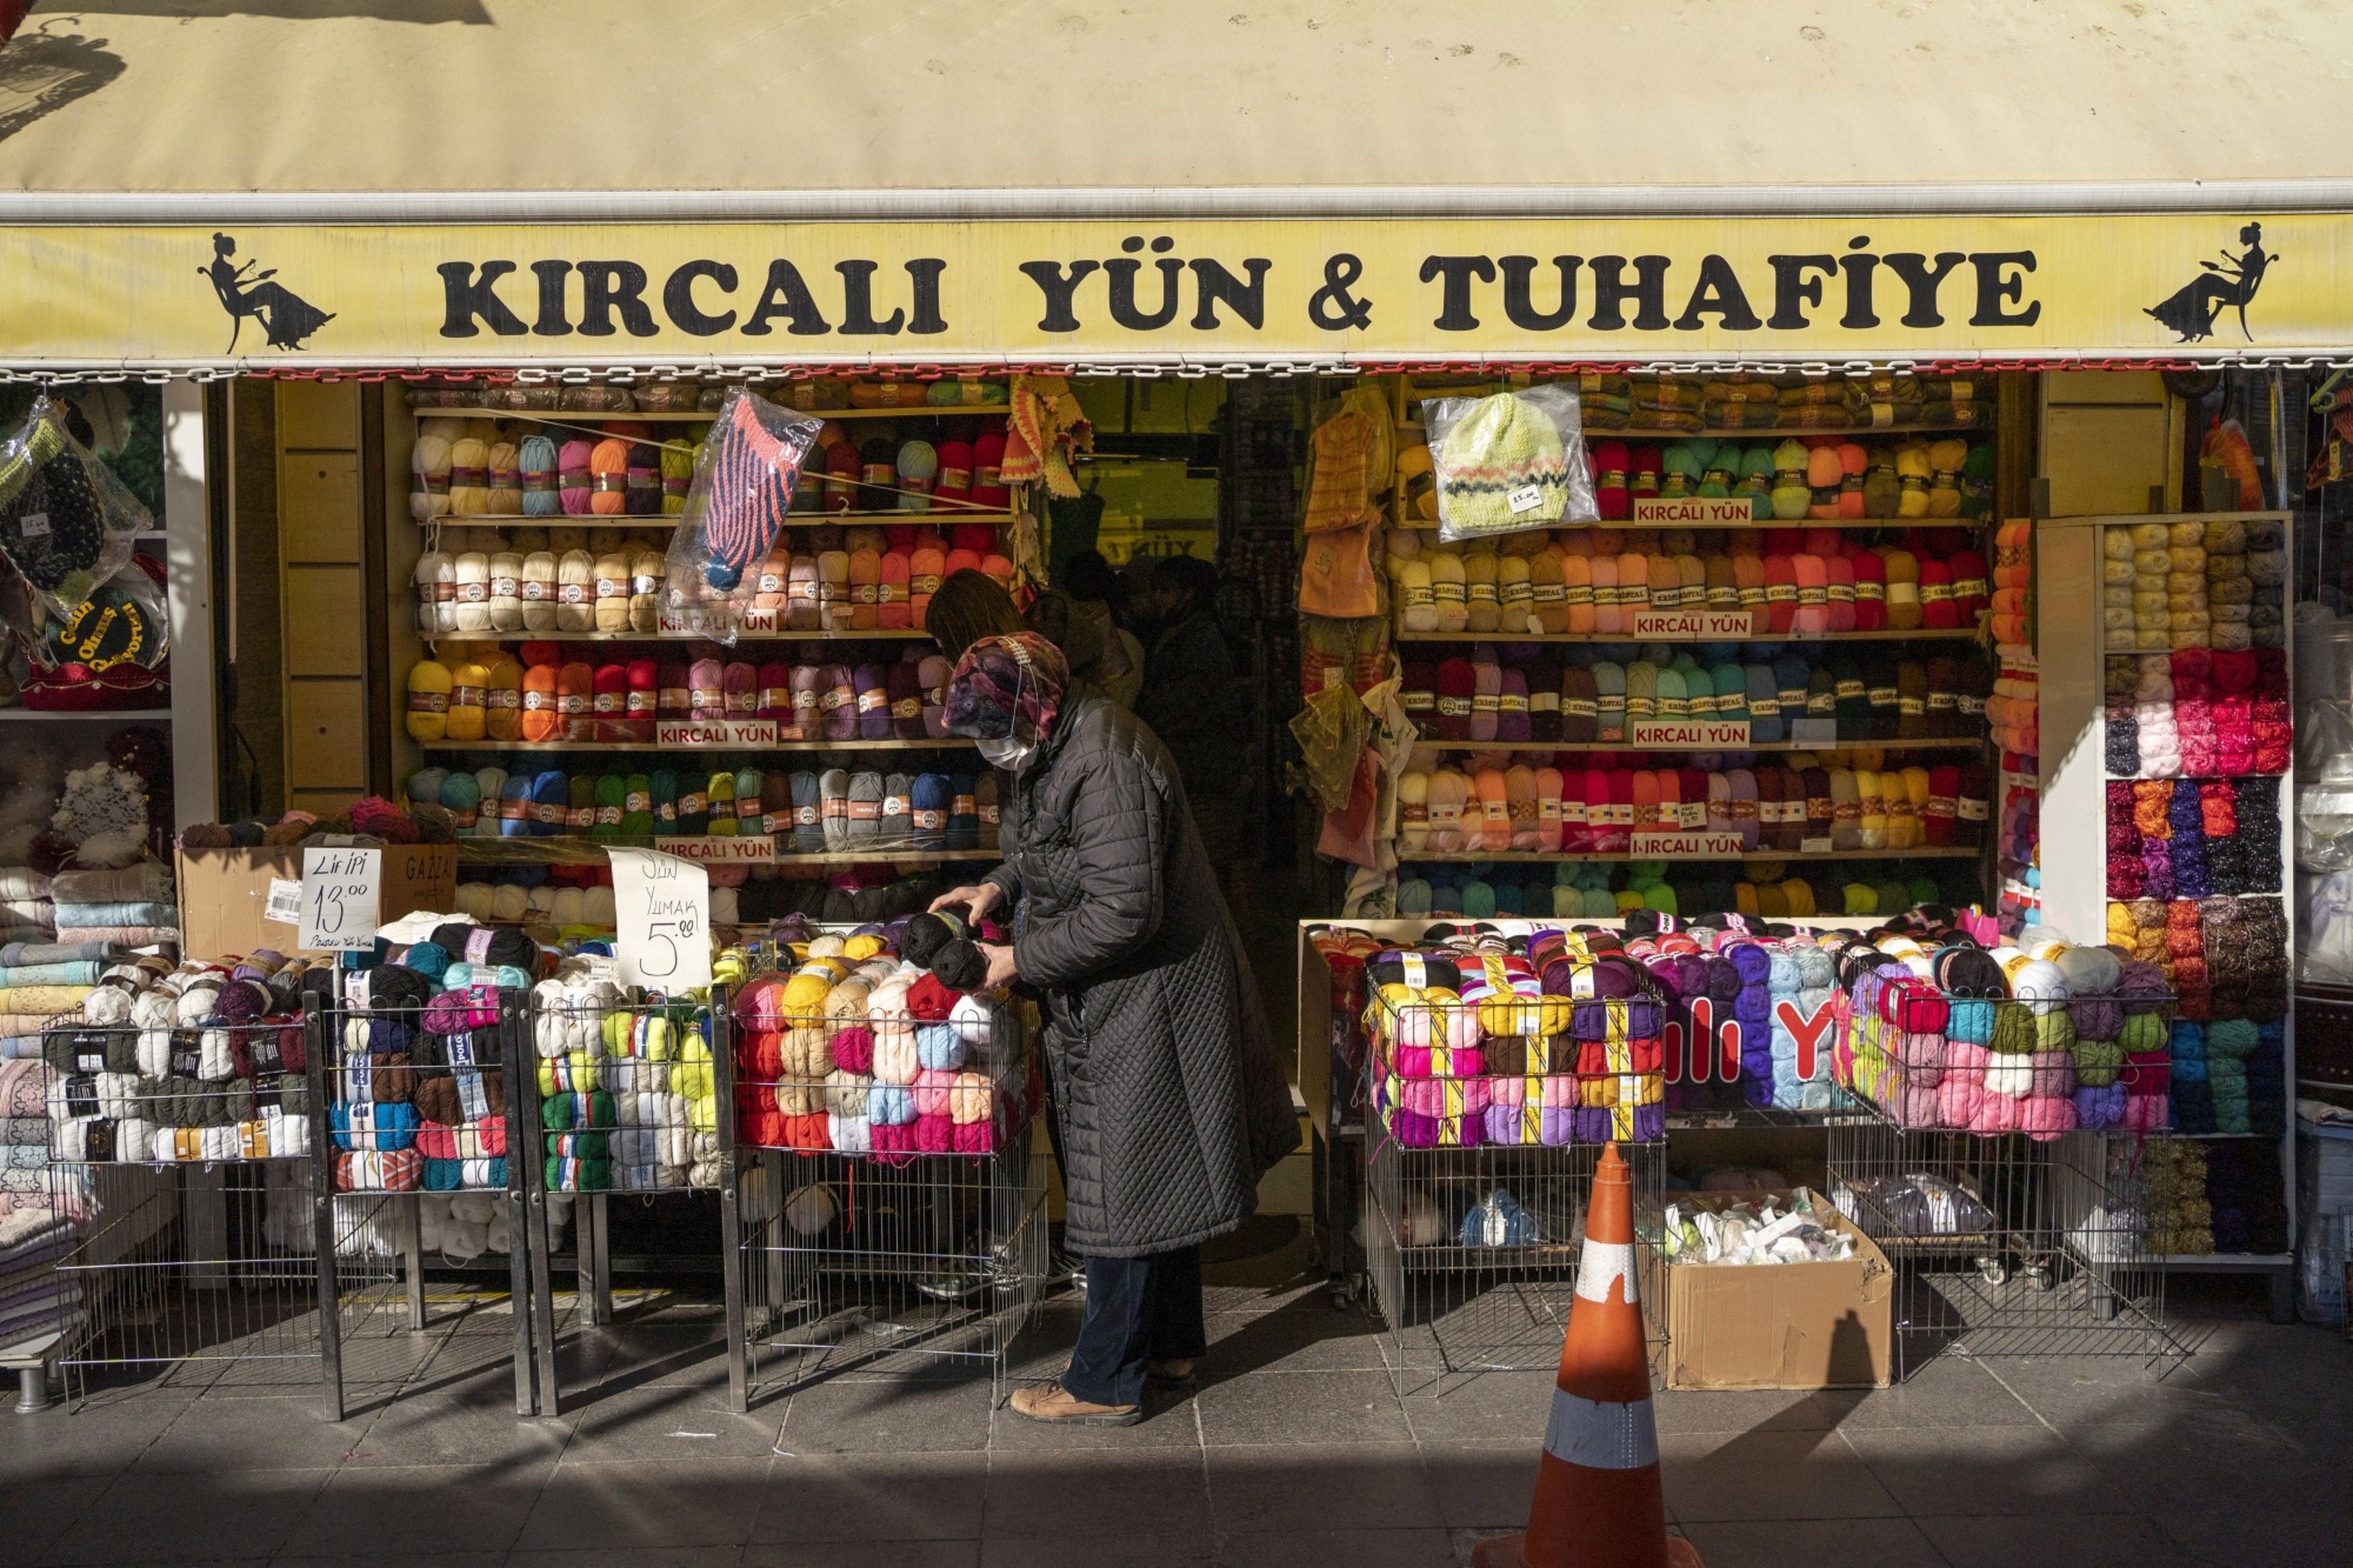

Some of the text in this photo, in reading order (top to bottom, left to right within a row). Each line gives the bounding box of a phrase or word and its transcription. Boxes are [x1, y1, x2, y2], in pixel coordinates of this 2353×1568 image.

[437, 236, 2041, 338] KIRCALI YÜN & TUHAFİYE
[1638, 501, 1748, 520] KIRCALI YÜN
[659, 612, 772, 631] KIRALI YÜN
[1637, 614, 1747, 632] KIRCALI YÜN
[661, 728, 728, 742] KIRCALI
[735, 724, 773, 742] YÜN
[1636, 728, 1701, 742] KIRCALI
[1708, 724, 1745, 742] YÜN
[659, 840, 771, 858] KIRCALI YÜN
[1706, 835, 1744, 853] YÜN
